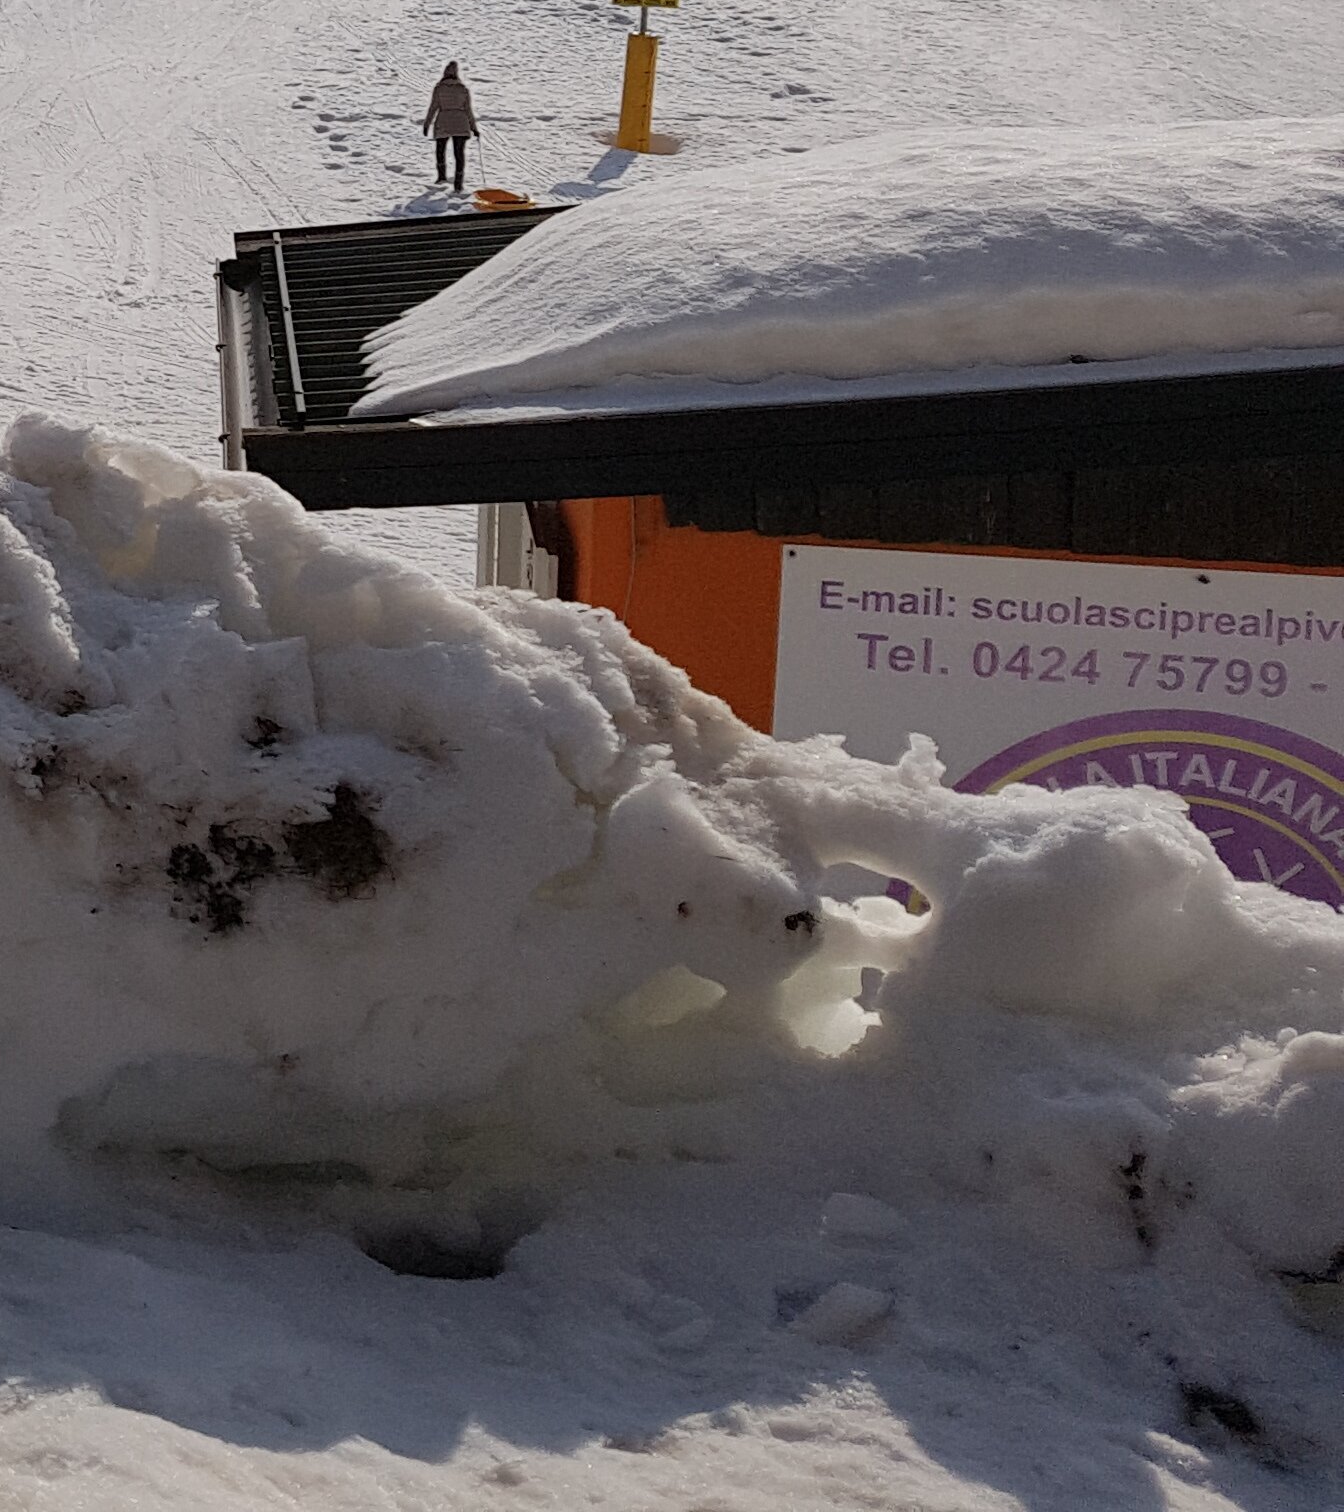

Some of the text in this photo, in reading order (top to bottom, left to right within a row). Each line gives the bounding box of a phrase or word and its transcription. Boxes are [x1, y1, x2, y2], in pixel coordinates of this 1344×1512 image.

[819, 579, 1344, 646] E-mail: scuolasciprealpiv
[857, 632, 949, 675] Tel.
[972, 640, 1101, 685] 0424
[1122, 649, 1289, 698] 75799
